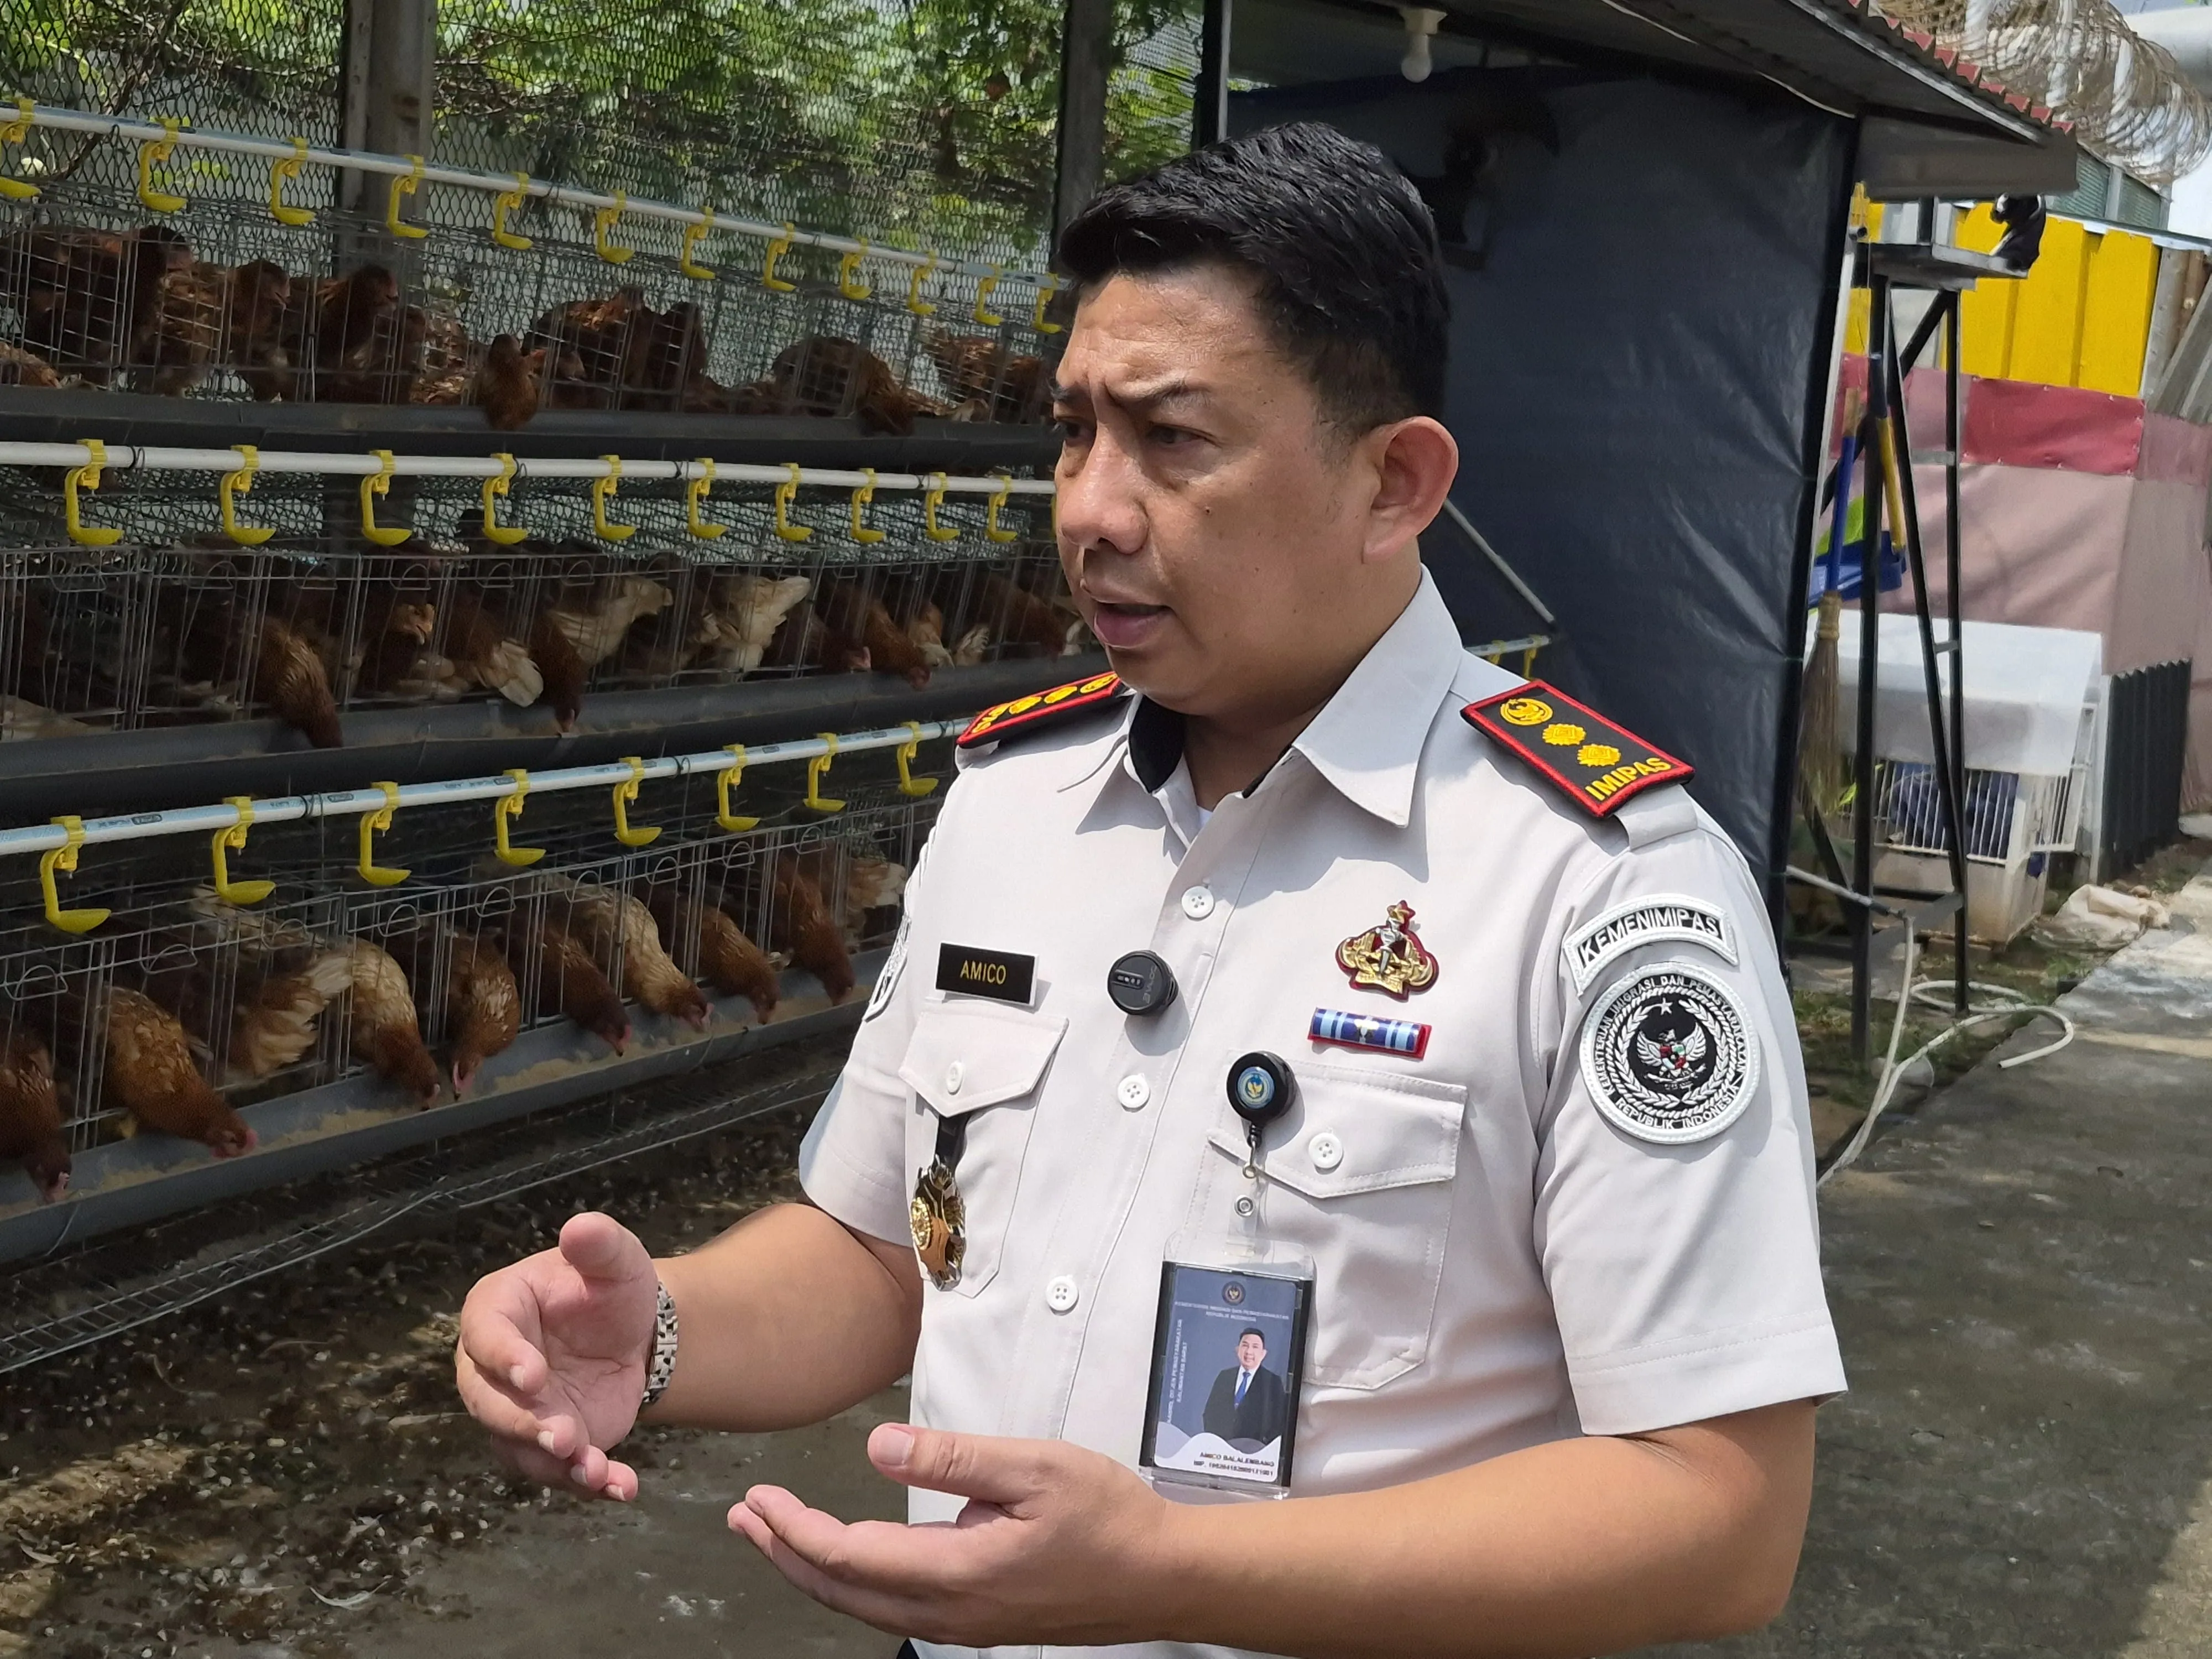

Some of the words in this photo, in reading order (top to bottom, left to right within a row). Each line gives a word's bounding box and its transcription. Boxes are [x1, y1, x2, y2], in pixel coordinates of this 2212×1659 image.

[1585, 757, 1671, 801] IMIPAS
[1580, 907, 1719, 967] KEMENIMIPAS
[959, 959, 1006, 984] AMICO
[1595, 1015, 1616, 1096] KEMENTERIAN
[1610, 977, 1655, 1018] IMIGRASI
[1660, 974, 1685, 987] DAN
[1615, 1097, 1674, 1129] REPUBLIK
[1682, 1084, 1741, 1129] INDONESIA
